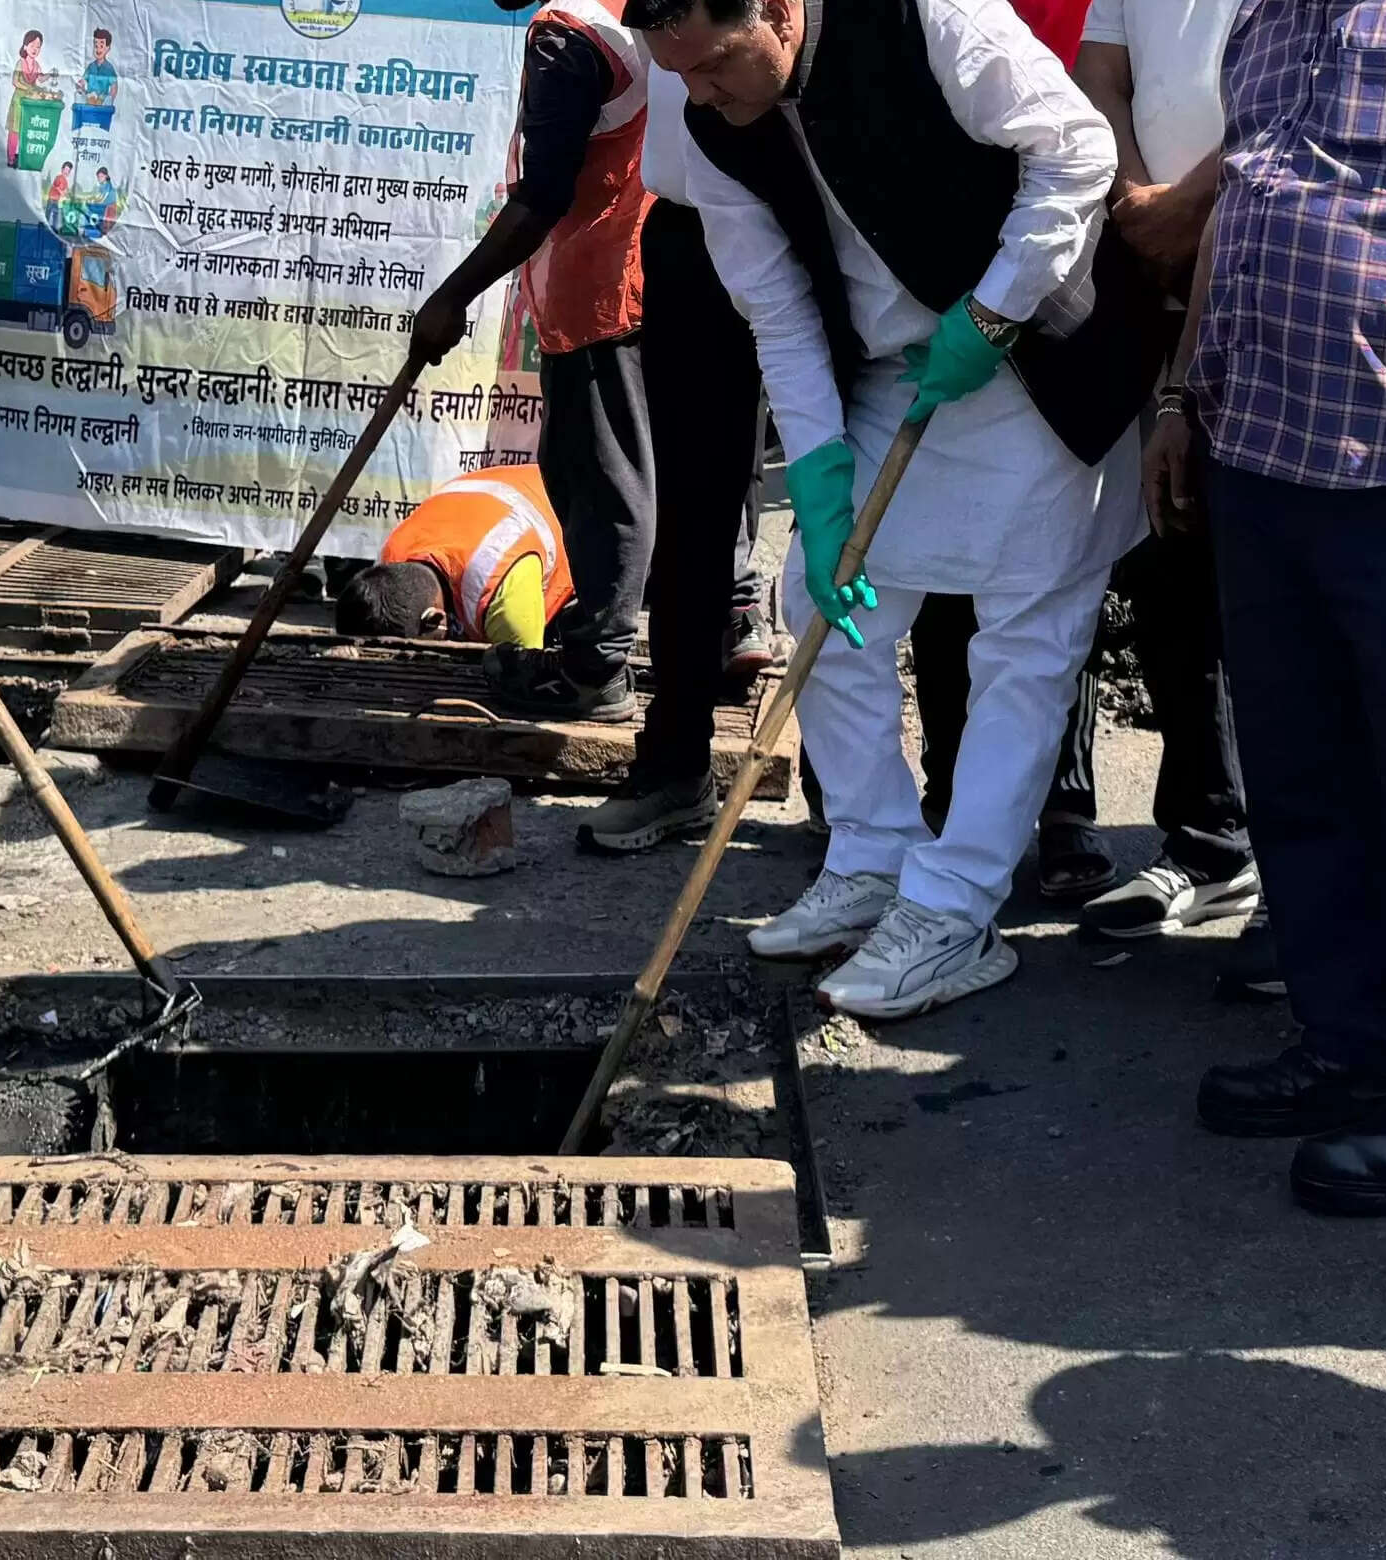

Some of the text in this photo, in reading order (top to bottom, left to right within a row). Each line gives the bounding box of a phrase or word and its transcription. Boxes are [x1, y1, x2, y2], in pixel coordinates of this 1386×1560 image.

[153, 39, 479, 103] विशेष स्वच्छता अभियान
[144, 104, 475, 156] नगर निगम हल्द्वानी काठगोदाम
[150, 159, 181, 182] शहर
[186, 155, 201, 182] के
[204, 163, 237, 190] मुख्य
[344, 175, 373, 197] द्वारा
[377, 178, 409, 205] मुख्य
[413, 175, 468, 203] कार्यक्रम
[230, 204, 274, 235] सफाई
[331, 212, 391, 242] अभियान
[175, 251, 200, 272] जन
[283, 255, 343, 285] अभियान
[347, 257, 376, 287] और
[126, 286, 170, 313] विशेष
[174, 295, 201, 315] रूप
[205, 293, 219, 317] से
[224, 297, 280, 322] महापौर
[318, 304, 393, 332] आयोजित
[52, 352, 127, 397] हल्द्वानी,
[137, 364, 193, 405] सुन्दर
[284, 377, 342, 410] हमारा
[430, 383, 483, 424] हमारी
[0, 406, 30, 432] नगर
[34, 404, 76, 437] निगम
[80, 413, 140, 446] हल्द्वानी
[192, 416, 229, 439] विशाल
[122, 475, 143, 496] हम
[174, 474, 224, 503] मिलकर
[228, 480, 260, 505] अपने
[265, 489, 293, 510] नगर
[363, 490, 391, 518] और
